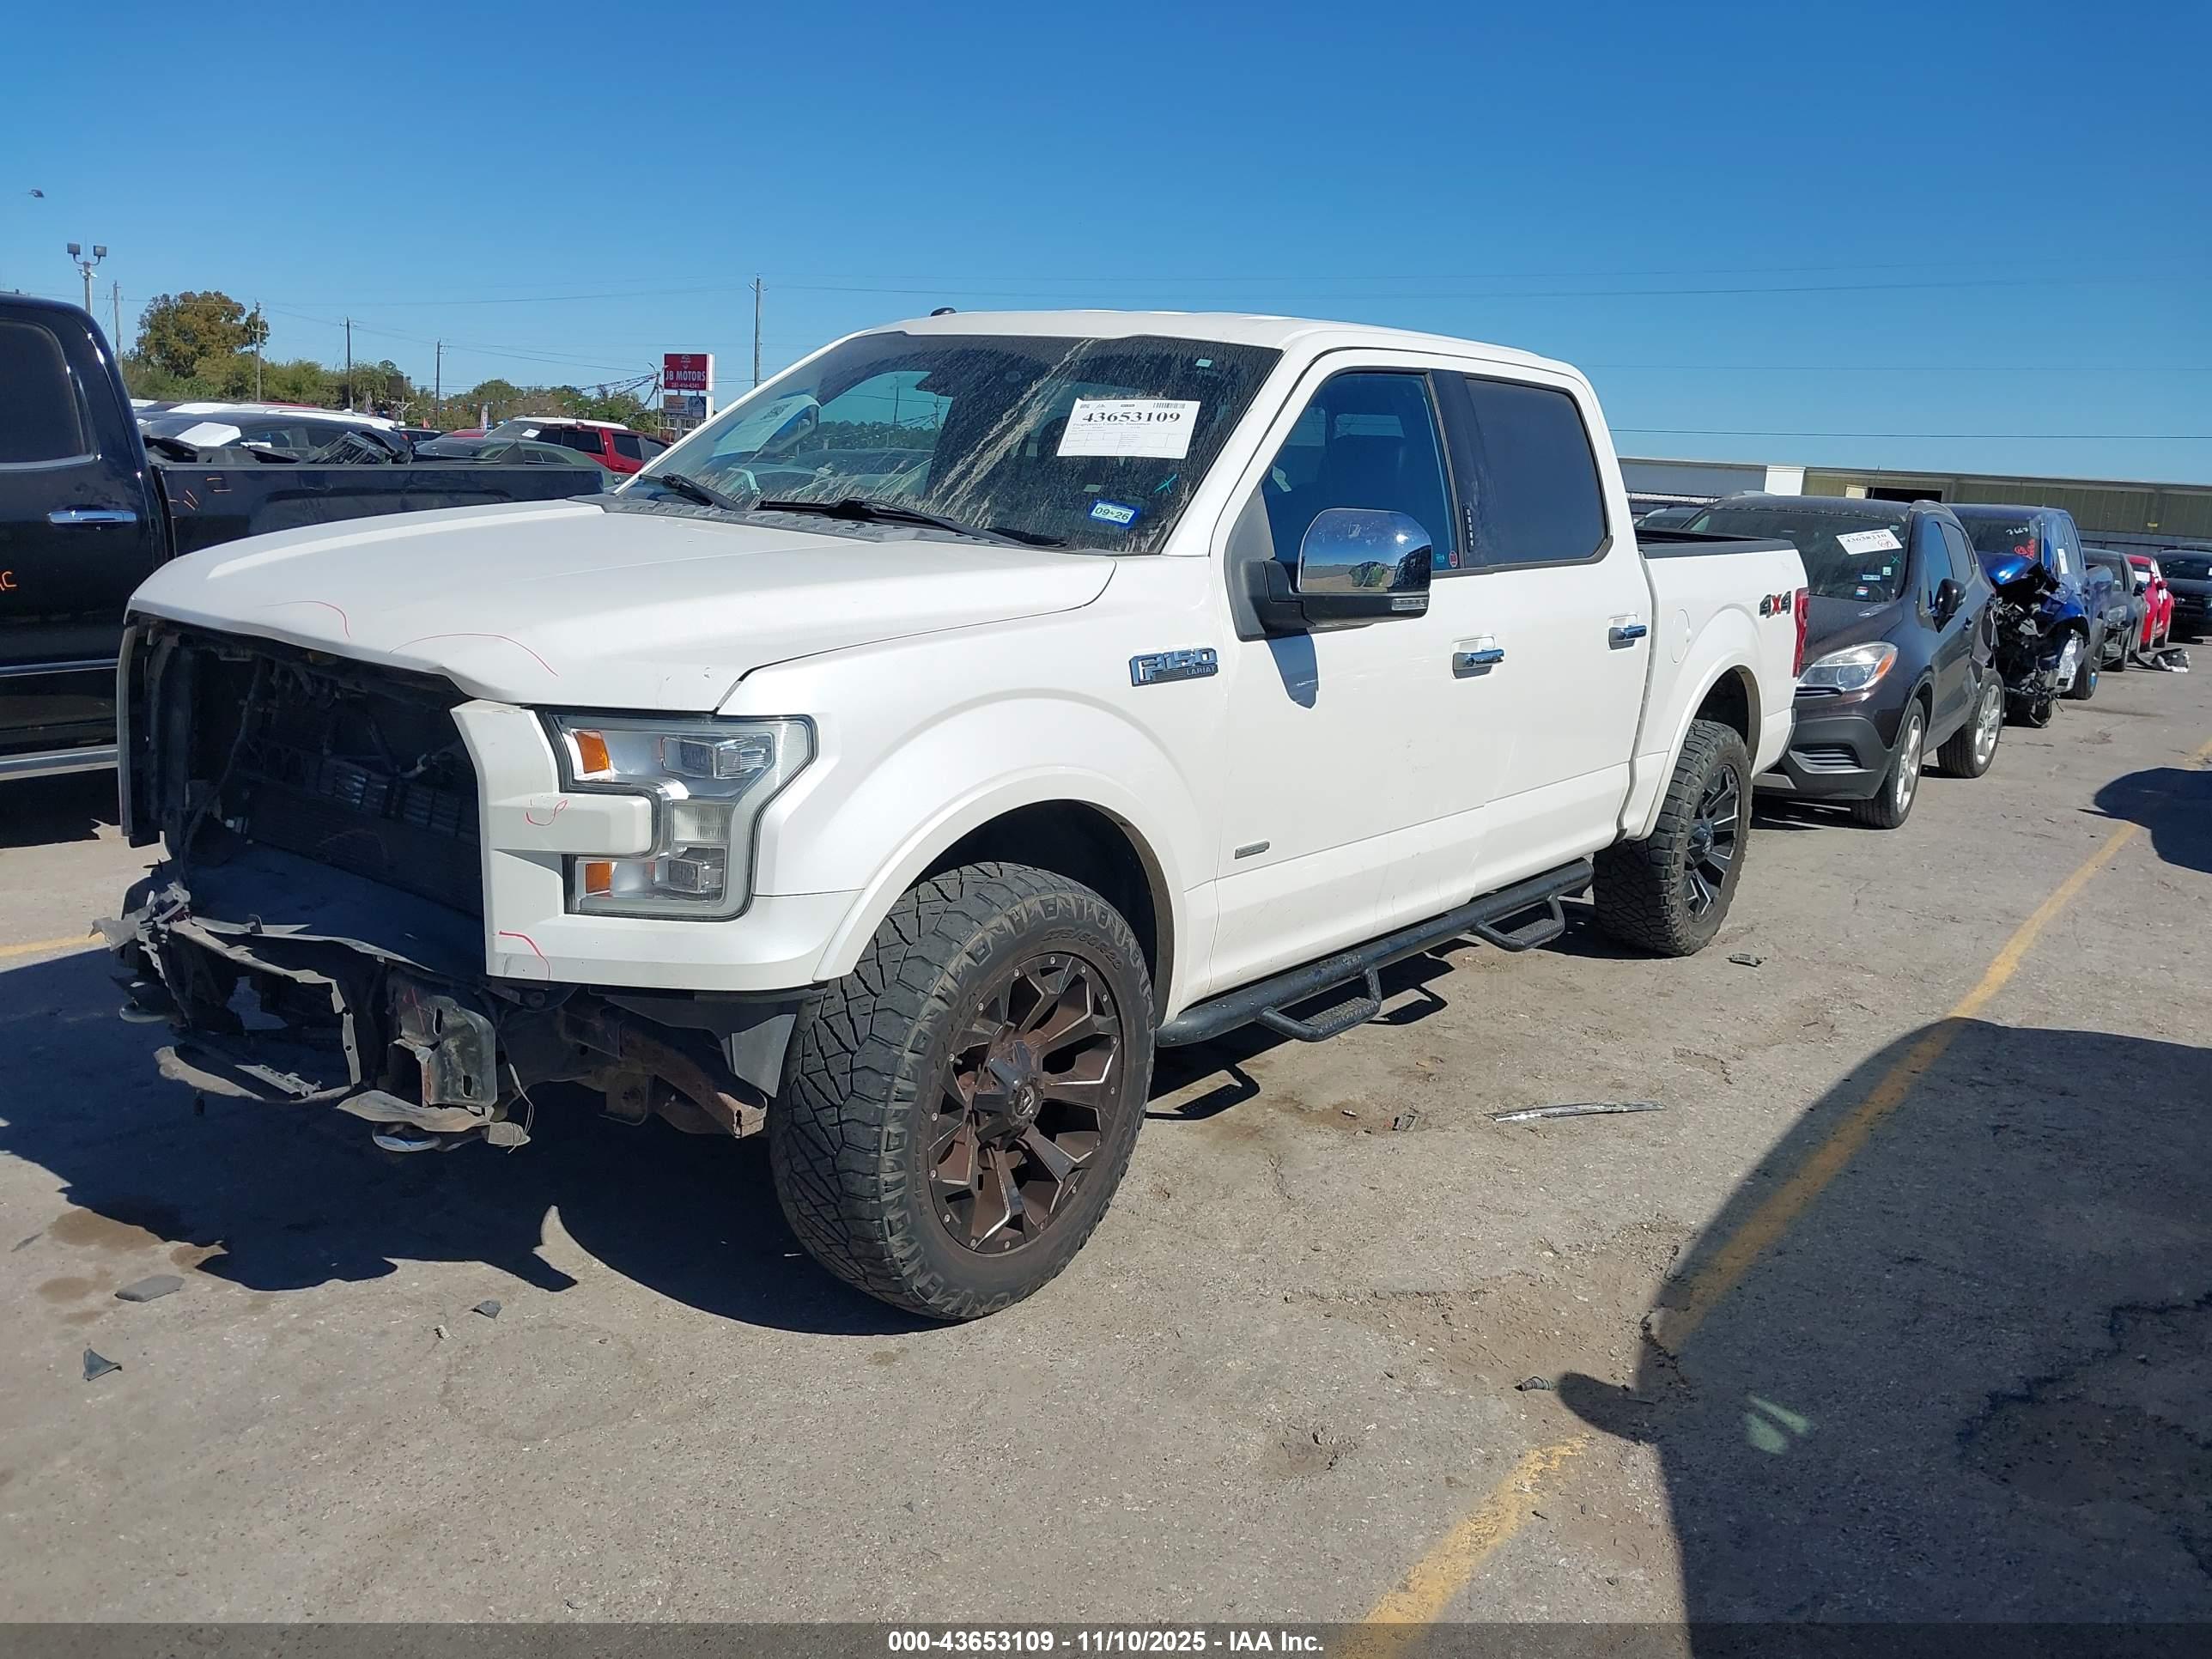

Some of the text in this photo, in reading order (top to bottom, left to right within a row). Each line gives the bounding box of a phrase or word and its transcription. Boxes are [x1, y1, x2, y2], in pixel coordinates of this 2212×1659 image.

[665, 370, 706, 382] JB MOTORS
[1083, 411, 1181, 423] 43653109
[1186, 665, 1217, 676] LARIAT
